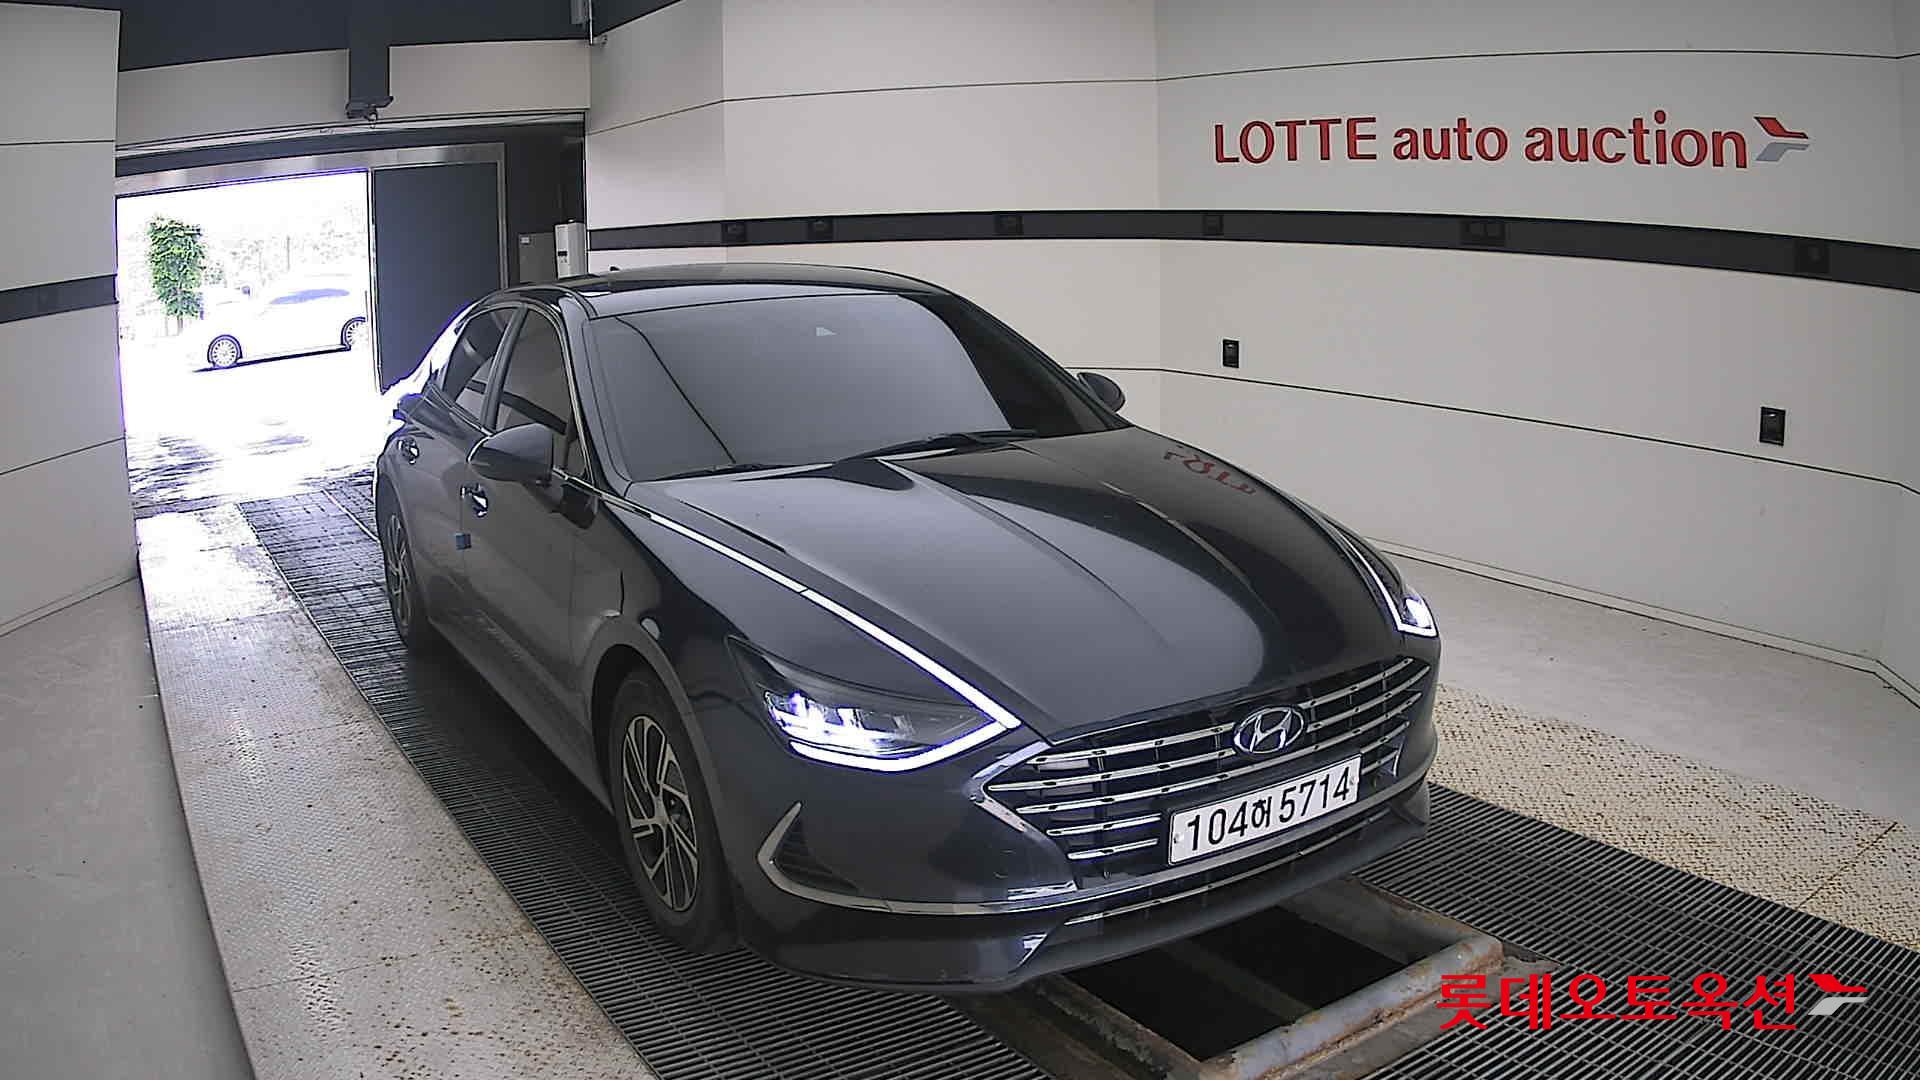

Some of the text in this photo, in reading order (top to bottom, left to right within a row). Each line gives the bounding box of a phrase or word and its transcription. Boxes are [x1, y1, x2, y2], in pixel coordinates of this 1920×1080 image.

[1214, 109, 1747, 169] LOTTE auto auction
